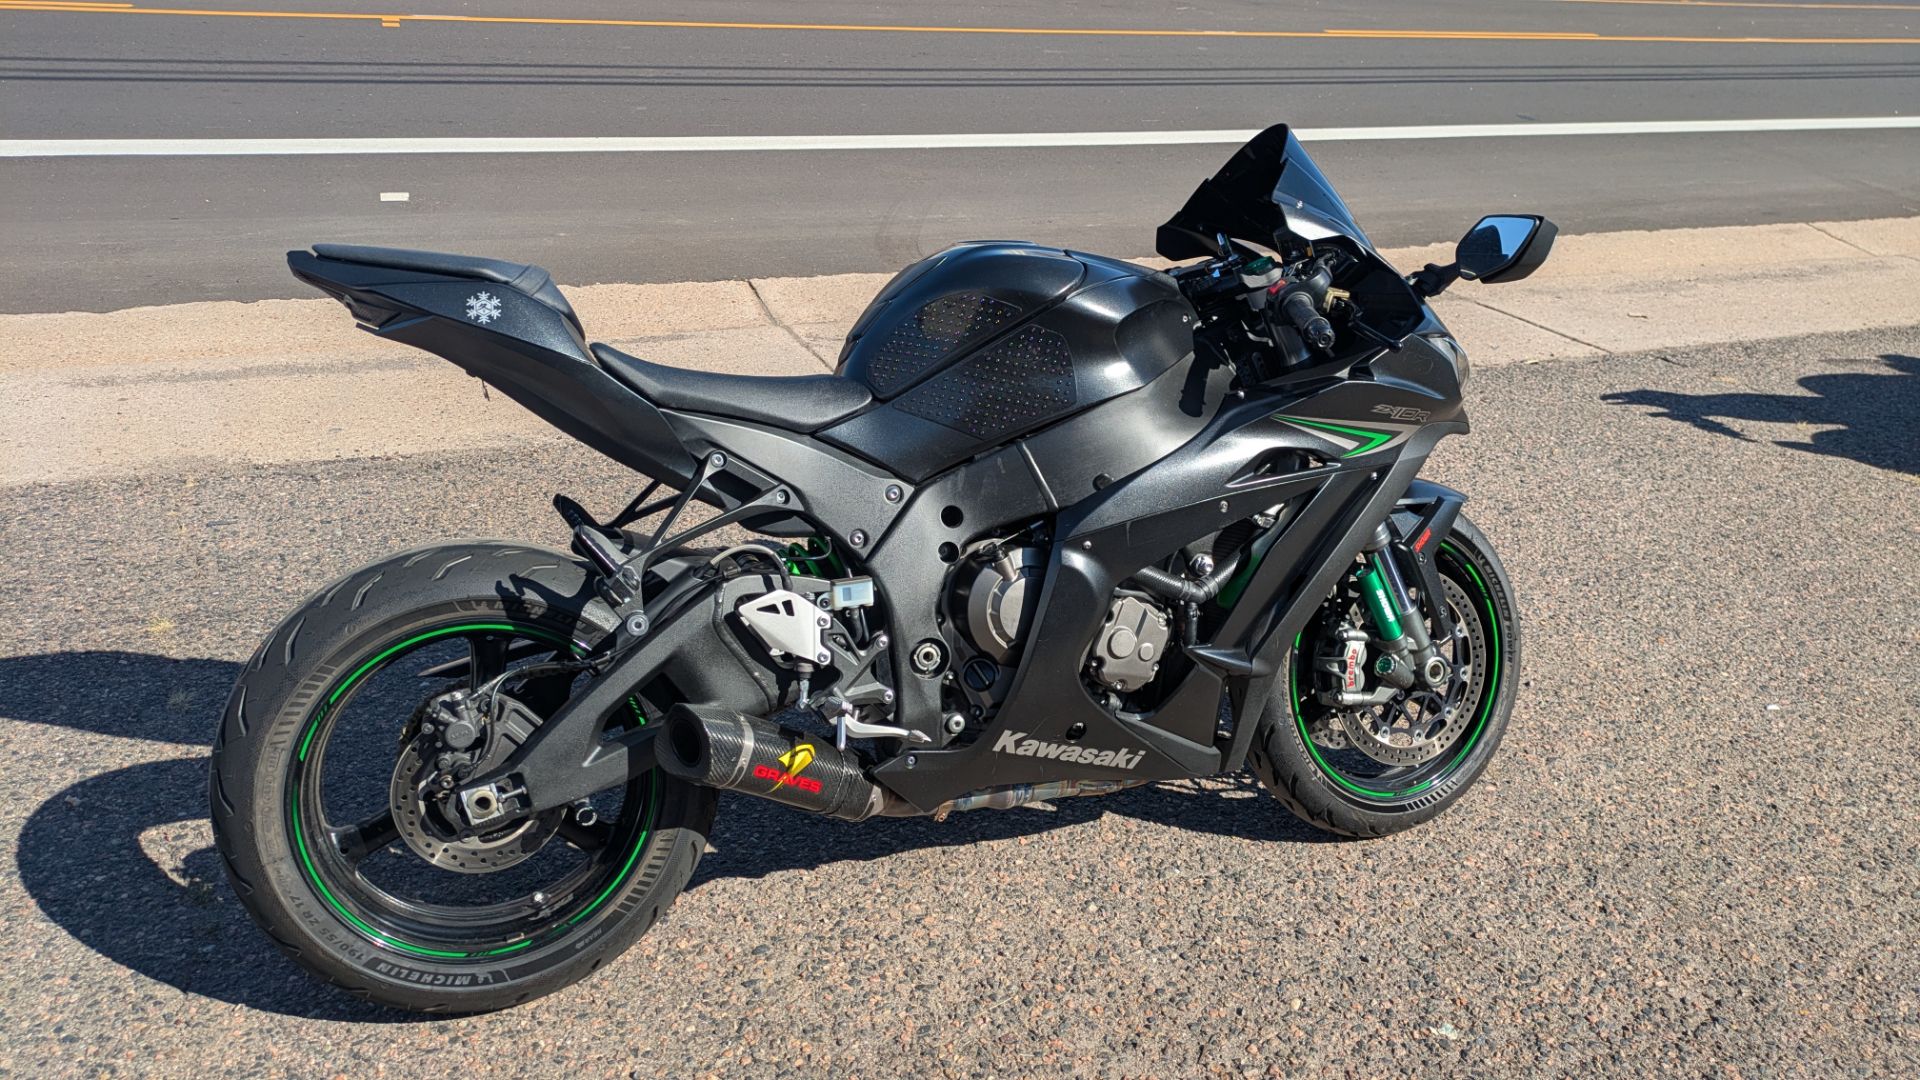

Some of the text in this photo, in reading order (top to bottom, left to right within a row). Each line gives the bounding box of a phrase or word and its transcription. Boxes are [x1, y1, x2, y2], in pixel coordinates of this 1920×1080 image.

[1484, 565, 1511, 619] MICHELIN
[1347, 648, 1357, 688] brembo
[992, 729, 1146, 770] Kawasaki
[753, 764, 823, 793] GRAVES
[375, 962, 471, 985] MICHELIN
